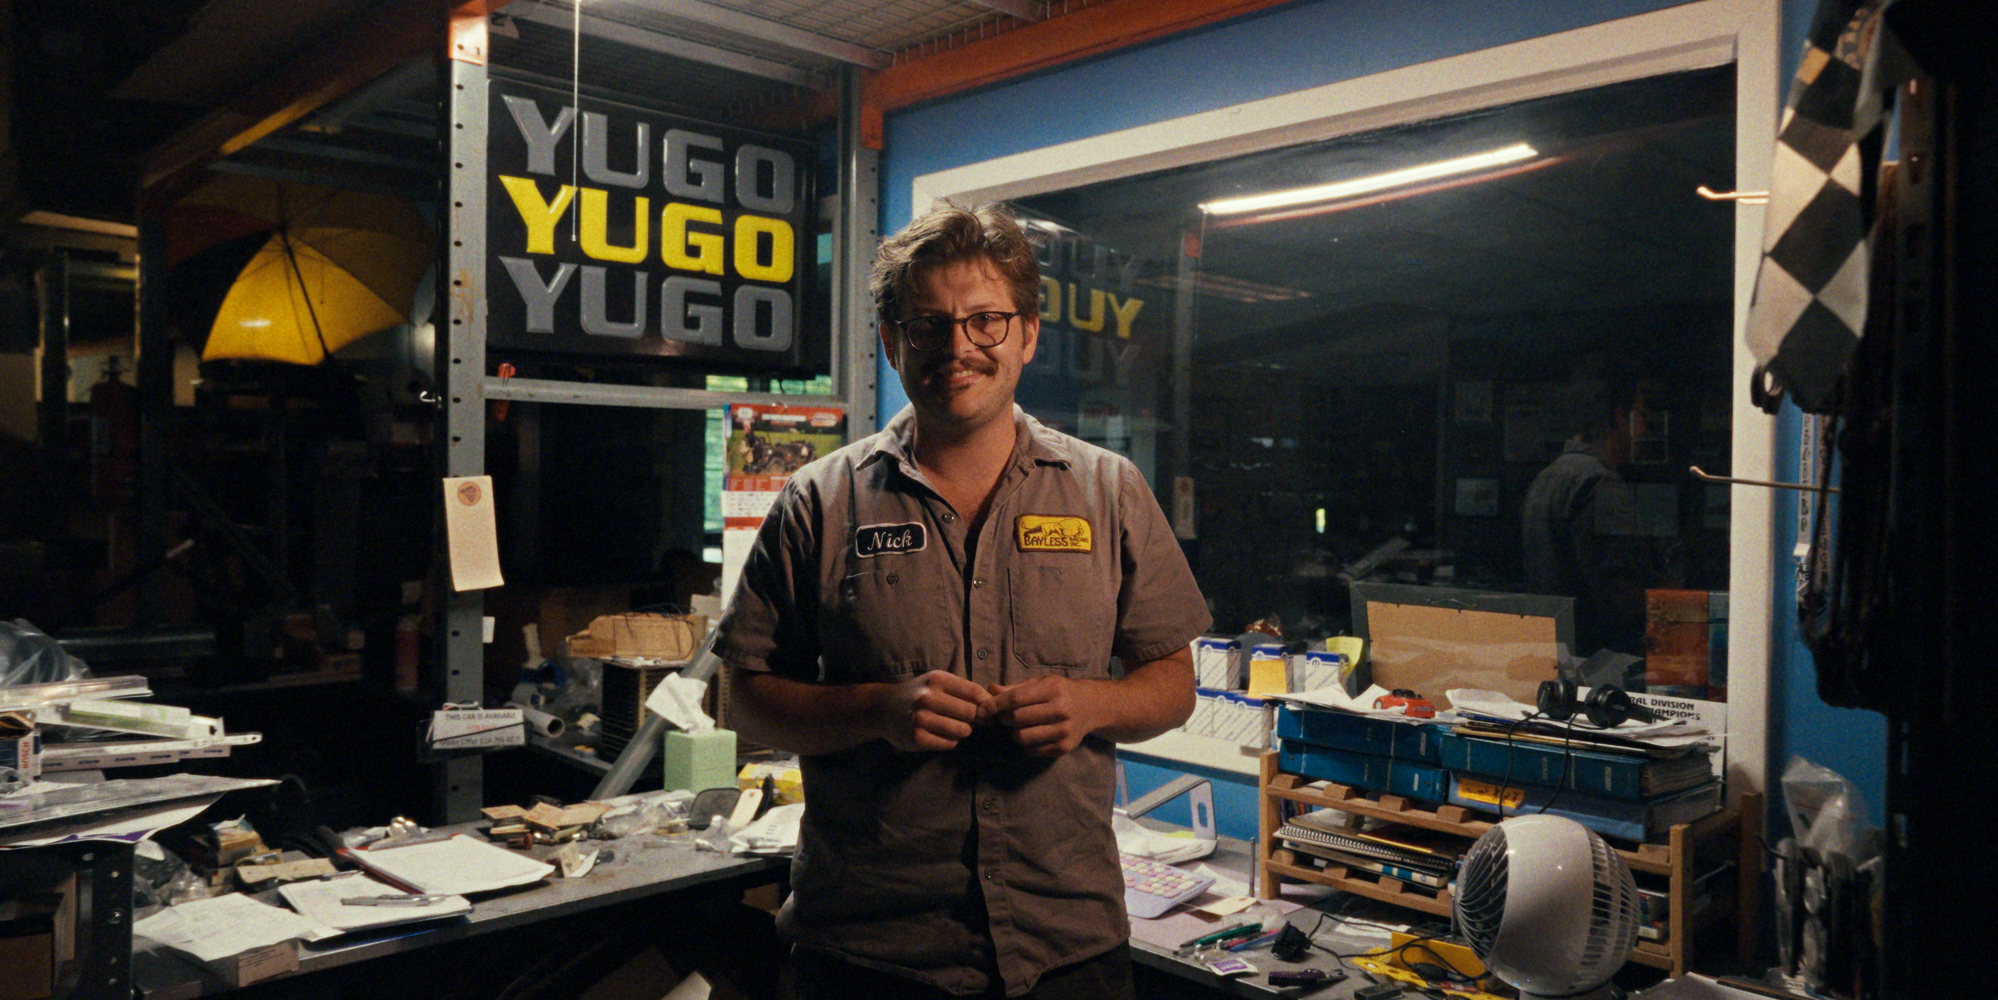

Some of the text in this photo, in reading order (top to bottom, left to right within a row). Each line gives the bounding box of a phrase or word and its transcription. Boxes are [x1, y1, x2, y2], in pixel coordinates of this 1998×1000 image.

[501, 94, 794, 213] YUGO
[498, 175, 795, 283] YUGO
[498, 256, 793, 352] YUGO
[867, 529, 913, 551] Nick
[1023, 535, 1069, 547] BAYLESS
[1630, 696, 1695, 710] RAL DIVISION
[446, 713, 461, 721] THIS
[1651, 708, 1702, 720] AMPIONS
